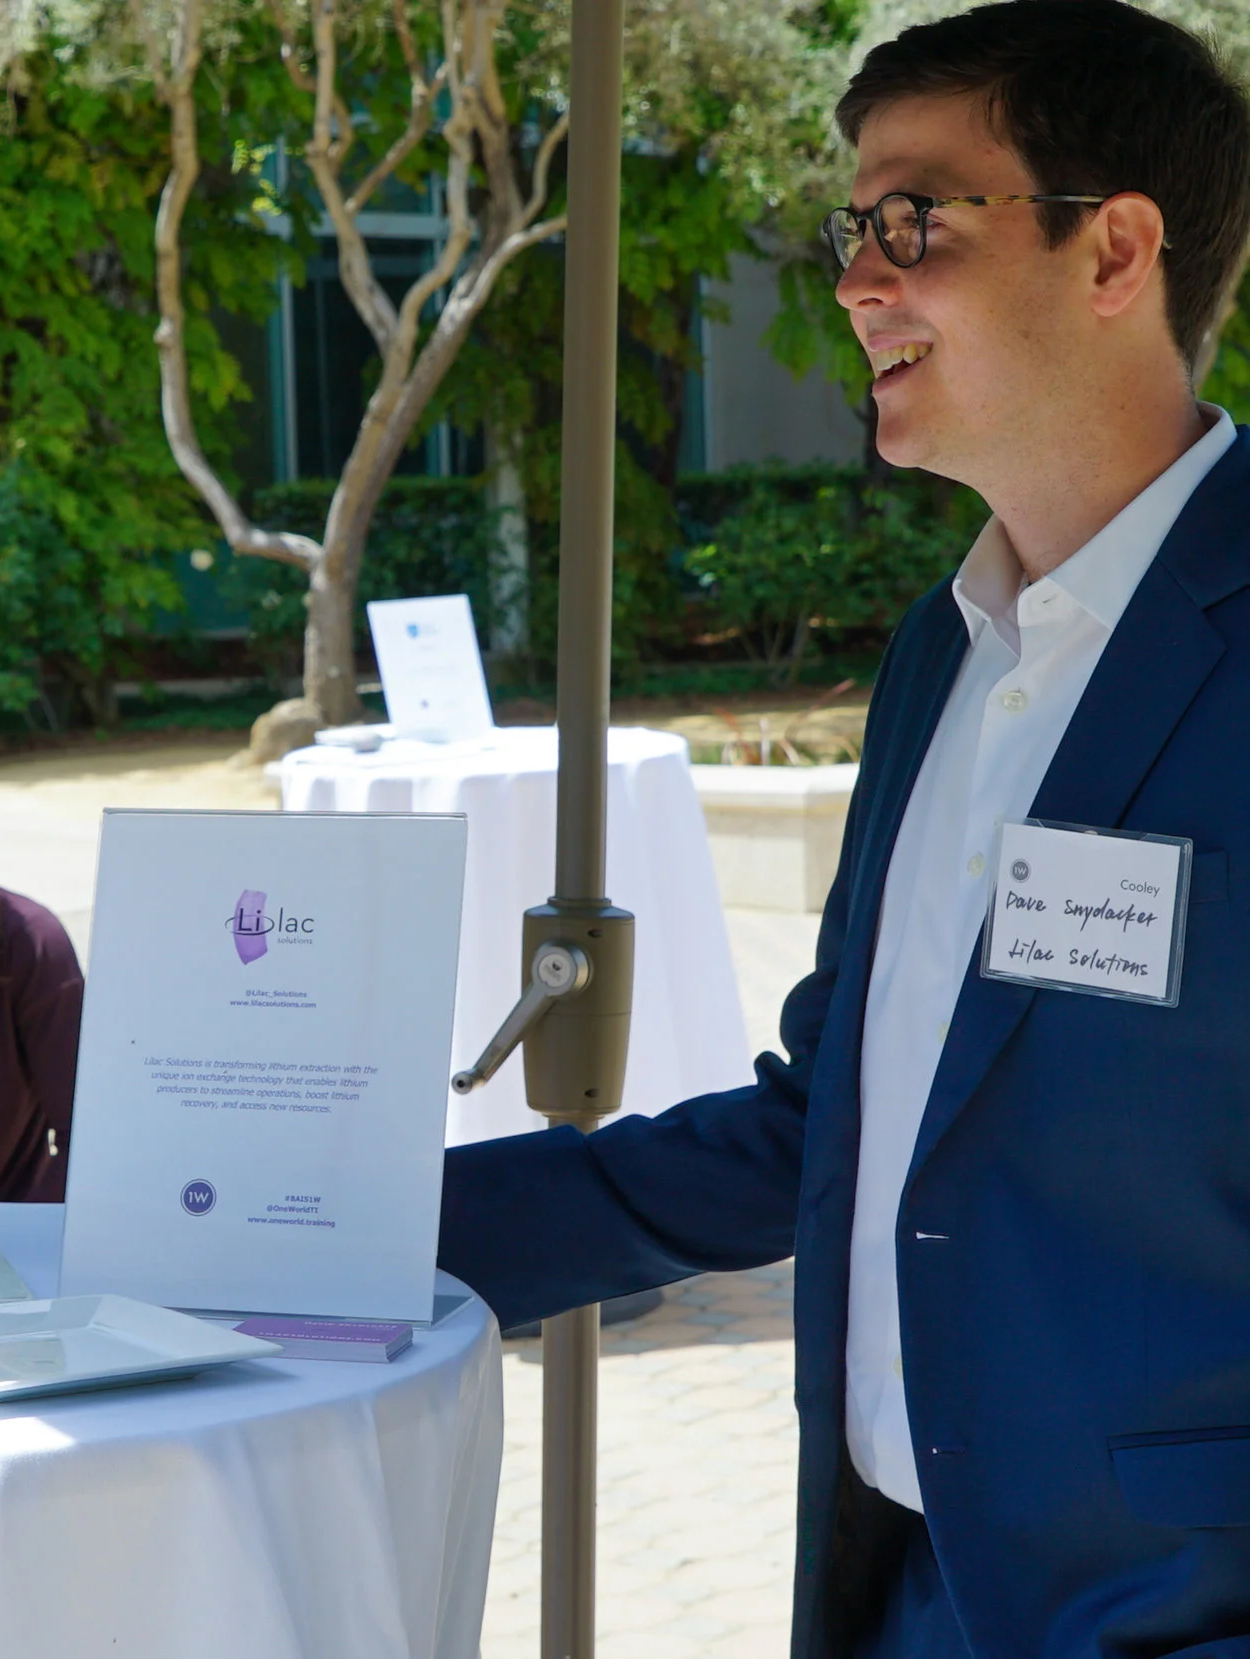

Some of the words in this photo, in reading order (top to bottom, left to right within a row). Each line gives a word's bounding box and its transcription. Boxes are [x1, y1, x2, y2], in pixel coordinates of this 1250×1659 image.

[1120, 879, 1161, 898] Cooley
[1006, 890, 1047, 912] Dave
[237, 907, 315, 933] Lilac
[277, 937, 313, 945] solutions
[1008, 938, 1054, 964] Lilac
[1069, 948, 1149, 977] Solutions
[230, 999, 317, 1009] www.lilacsolutions.com
[143, 1056, 163, 1066] Lilac
[166, 1057, 203, 1068] Solutions
[205, 1060, 212, 1068] is
[213, 1060, 267, 1071] transforming
[268, 1062, 297, 1071] lithium
[299, 1063, 341, 1073] extraction
[343, 1065, 362, 1074] with
[363, 1066, 378, 1075] the
[150, 1072, 180, 1081] unique
[196, 1073, 236, 1084] exchange
[238, 1074, 285, 1086] technology
[286, 1076, 303, 1085] that
[304, 1077, 337, 1087] enables
[339, 1078, 368, 1088] lithium
[156, 1085, 197, 1095] producers
[200, 1086, 209, 1095] to
[211, 1087, 254, 1096] streamline
[305, 1090, 329, 1100] boost
[331, 1091, 360, 1101] lithium
[221, 1101, 238, 1109] and
[239, 1102, 267, 1111] access
[269, 1103, 287, 1111] new
[188, 1190, 210, 1204] 1W
[247, 1216, 336, 1229] www.oneworld.training
